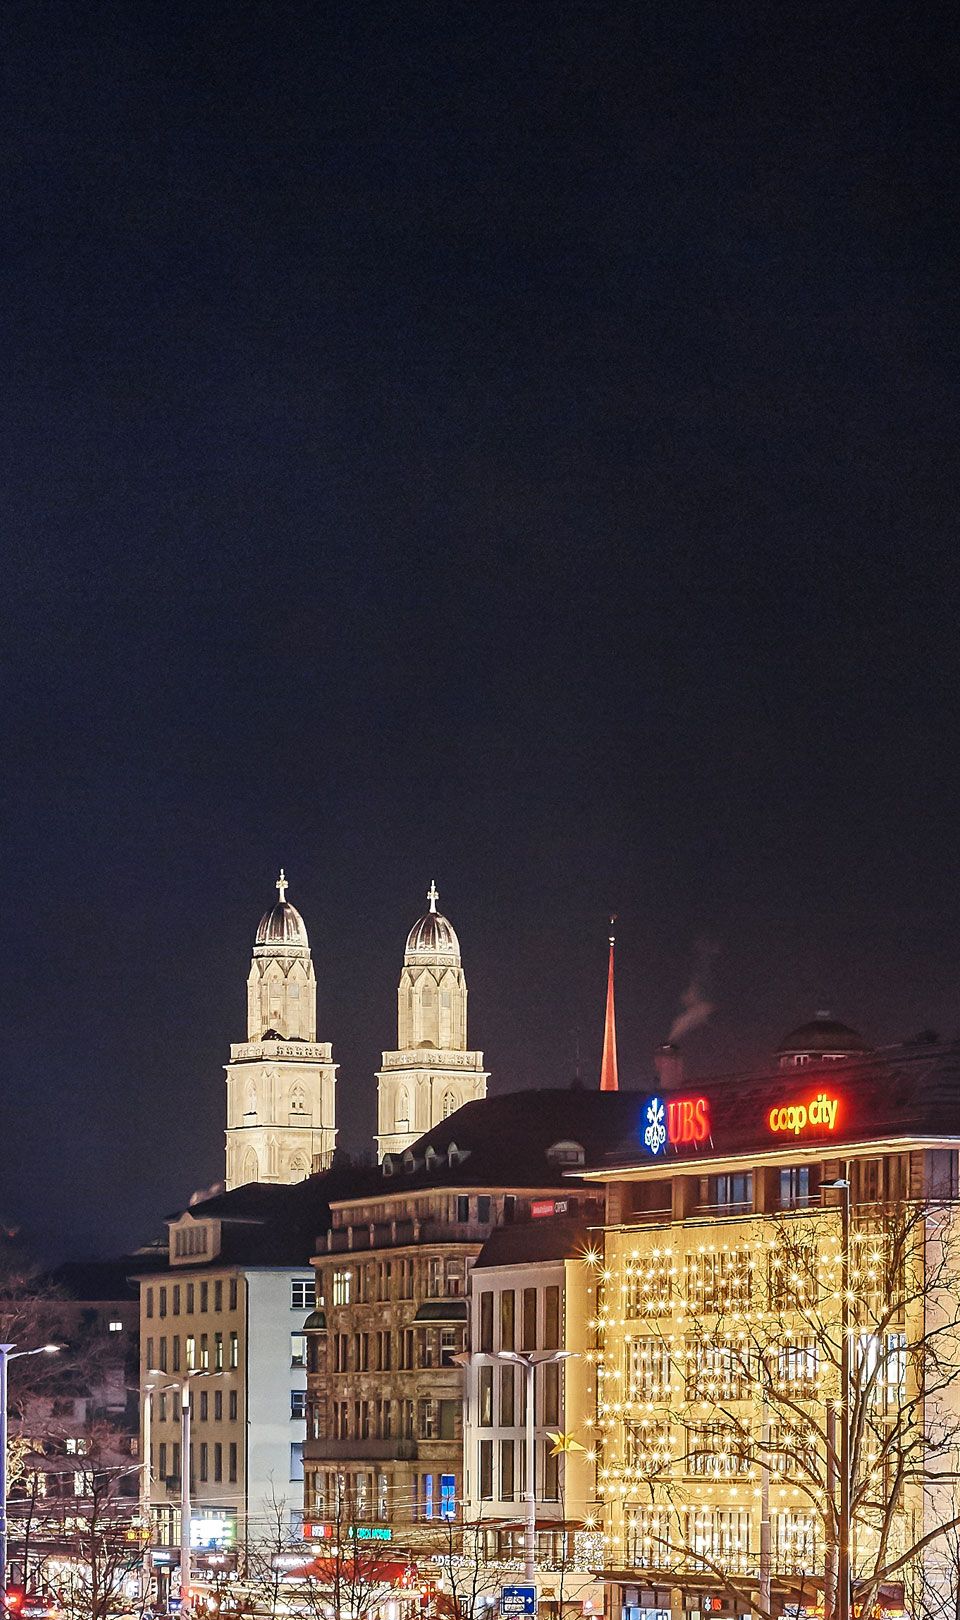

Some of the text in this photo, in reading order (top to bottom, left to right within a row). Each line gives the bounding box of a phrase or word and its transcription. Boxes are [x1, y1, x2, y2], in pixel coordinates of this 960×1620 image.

[668, 1100, 707, 1144] UBS
[770, 1094, 838, 1135] coop city
